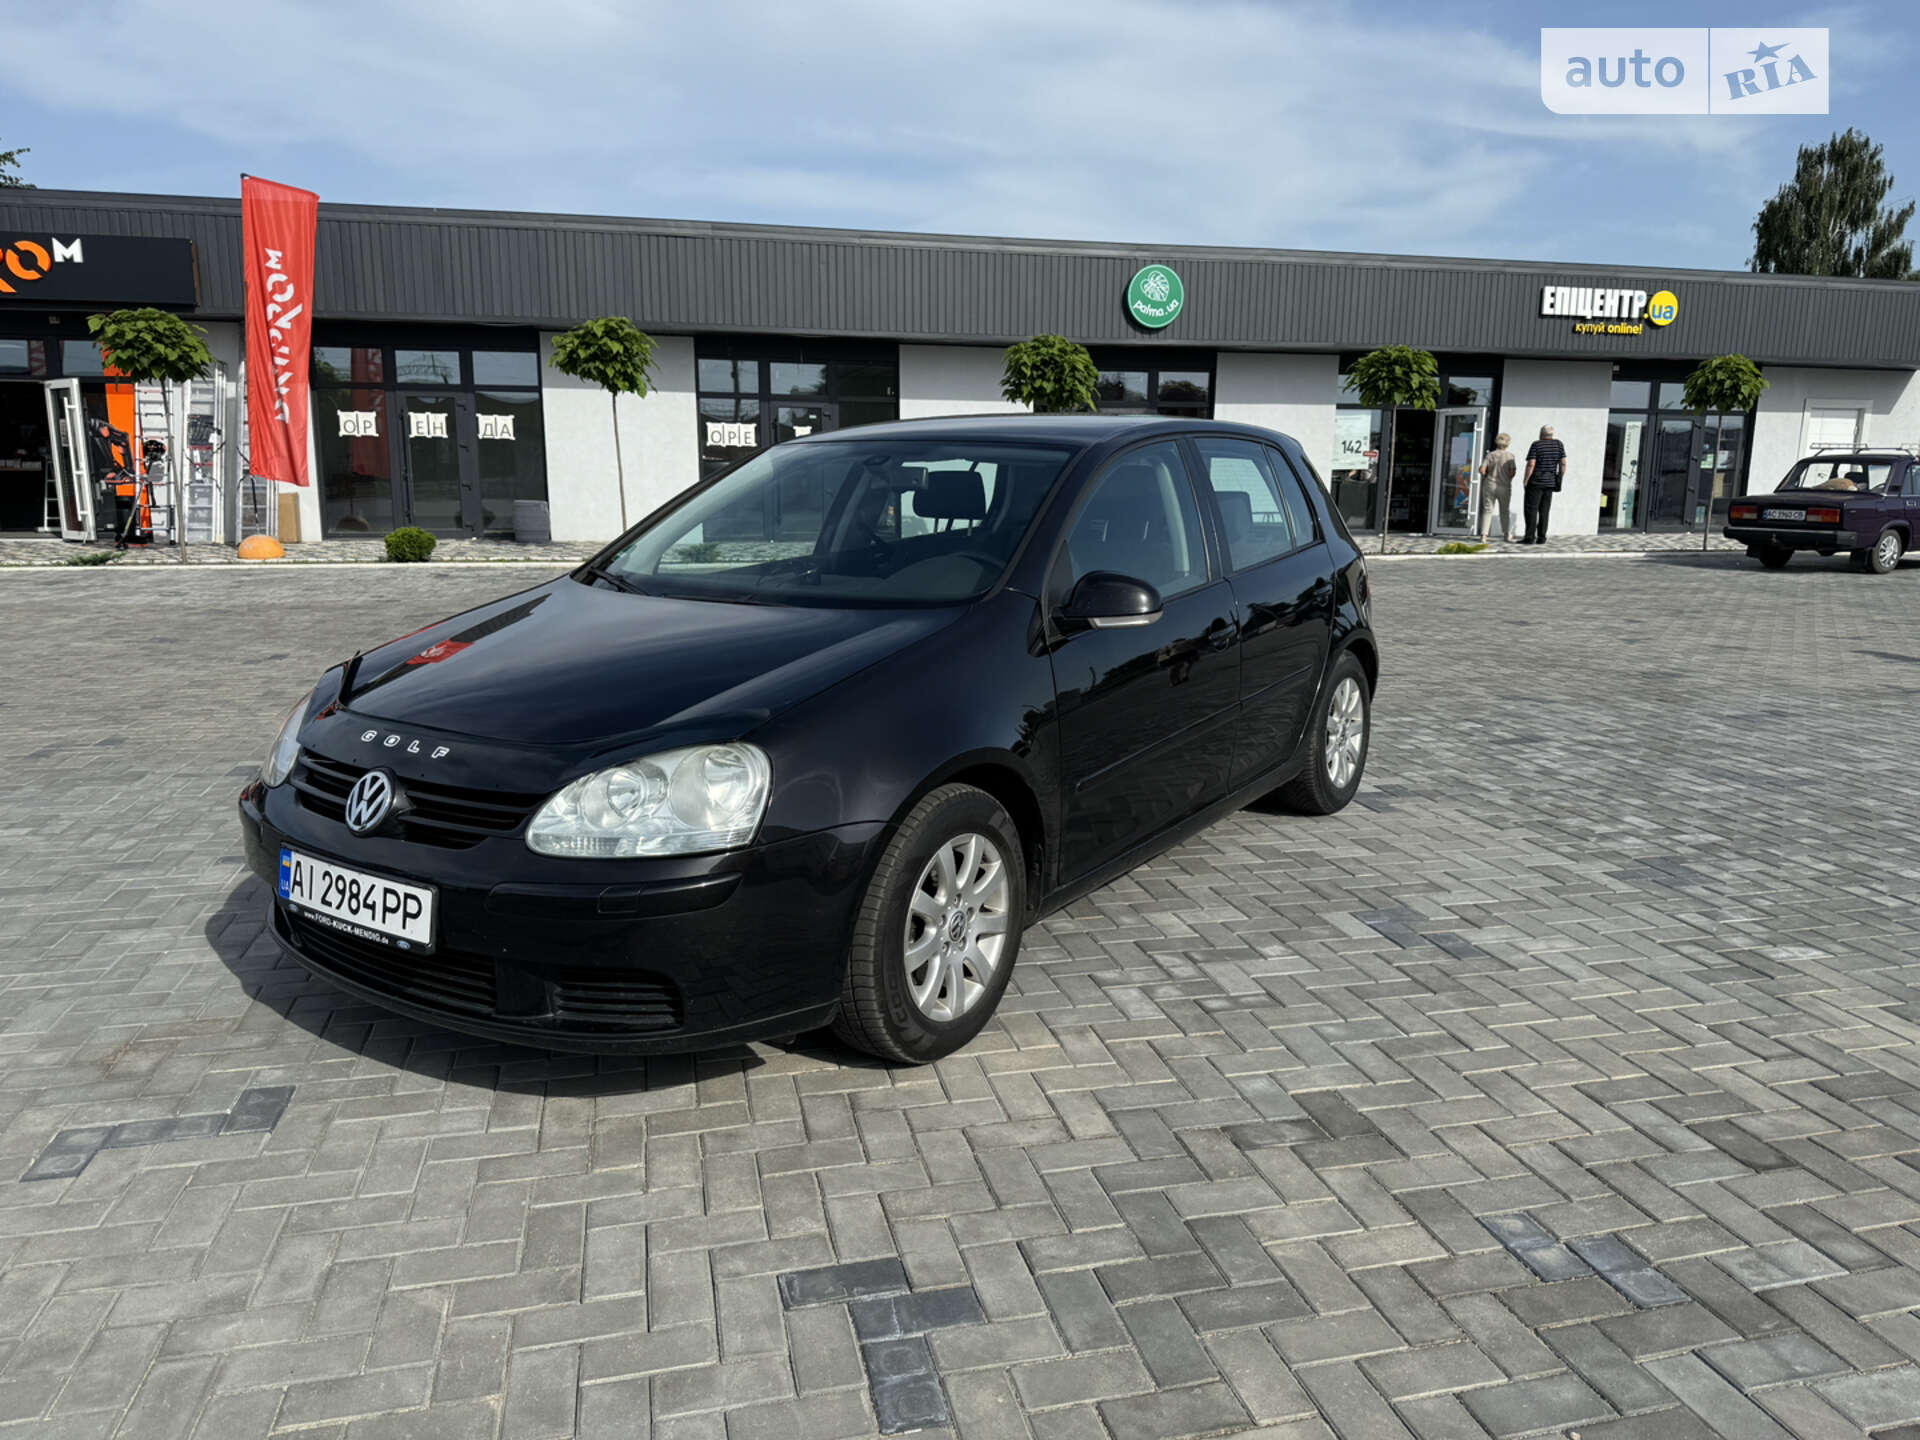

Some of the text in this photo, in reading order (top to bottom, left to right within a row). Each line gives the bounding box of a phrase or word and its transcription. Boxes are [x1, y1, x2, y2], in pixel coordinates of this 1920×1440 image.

[1607, 323, 1643, 335] online!
[1341, 440, 1362, 454] 142
[361, 730, 450, 758] GOLF
